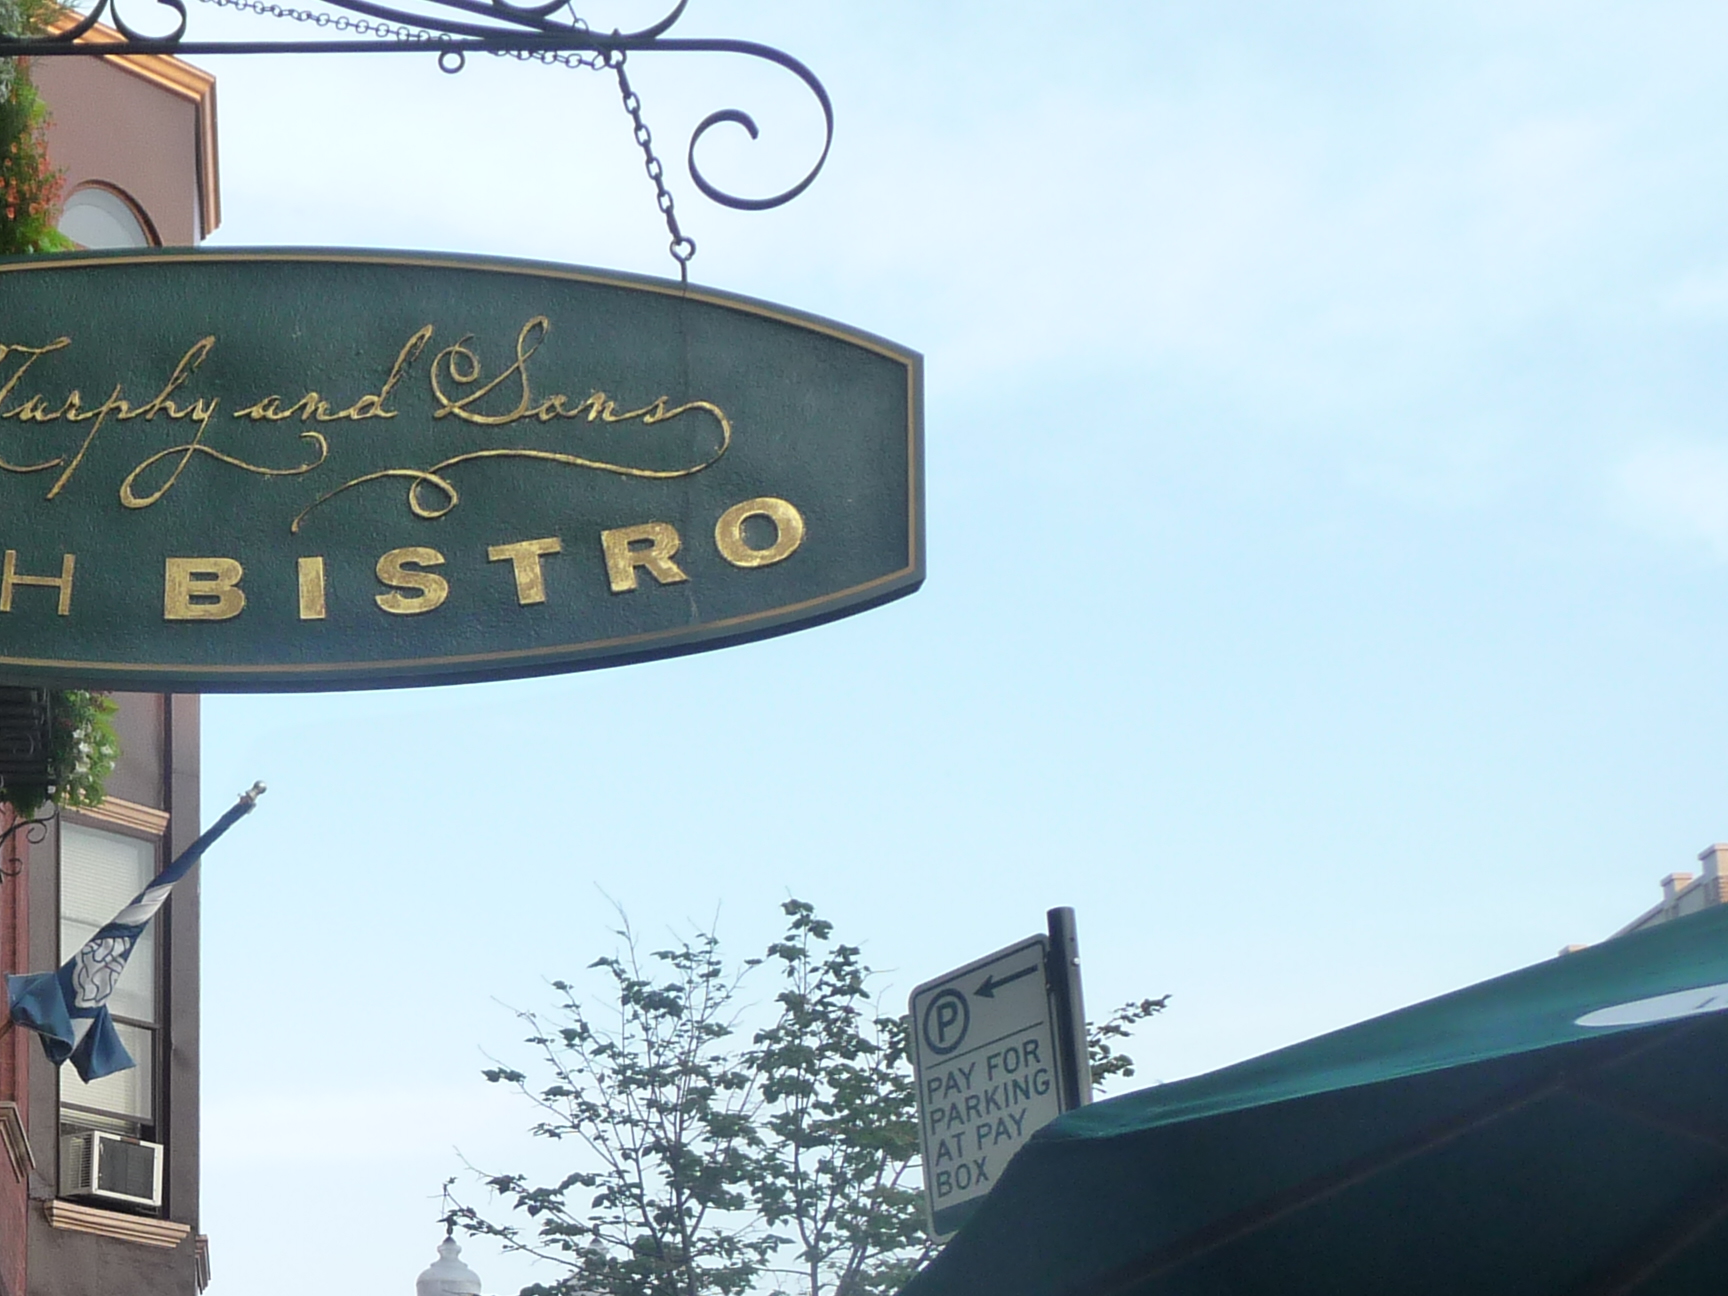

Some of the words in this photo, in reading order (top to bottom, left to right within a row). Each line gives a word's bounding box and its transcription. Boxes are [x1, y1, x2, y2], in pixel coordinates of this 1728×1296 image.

[232, 322, 400, 422] and
[163, 496, 805, 621] BISTRO
[927, 1061, 976, 1105] PAY
[986, 1037, 1041, 1083] FOR
[929, 1067, 1051, 1136] PARKING
[935, 1130, 966, 1167] AT
[976, 1107, 1028, 1151] PAY
[936, 1155, 990, 1199] BOX
